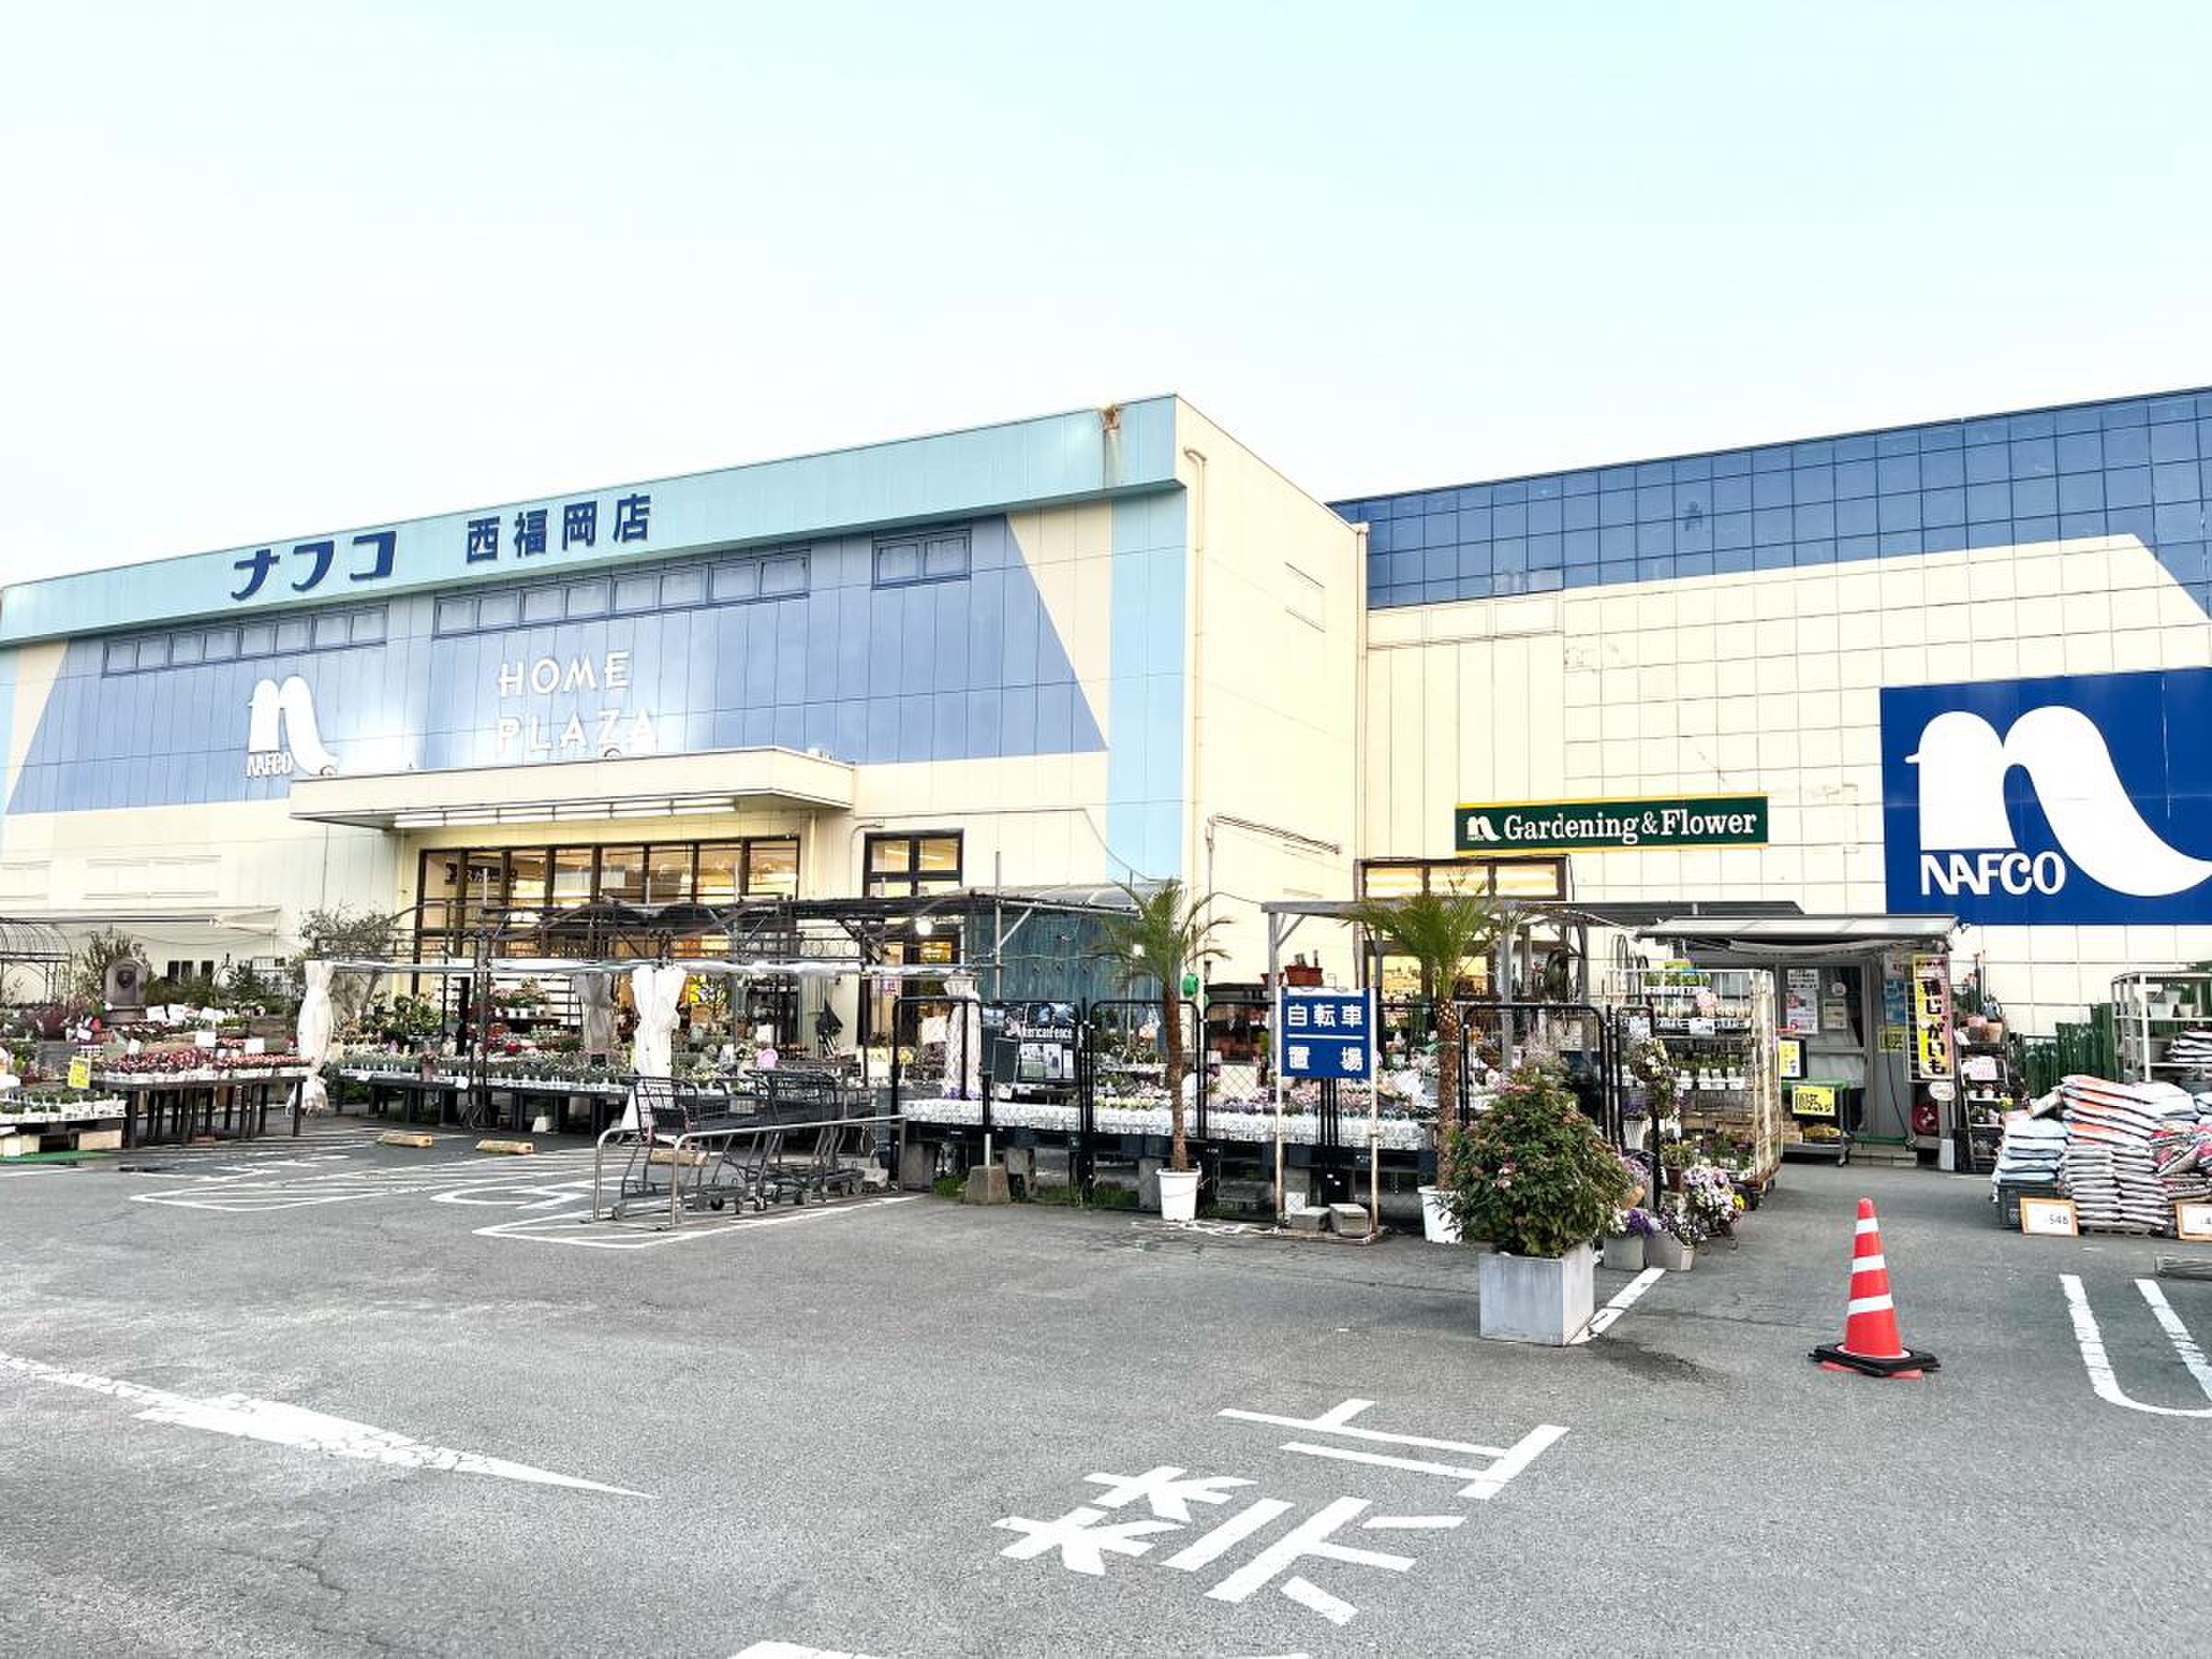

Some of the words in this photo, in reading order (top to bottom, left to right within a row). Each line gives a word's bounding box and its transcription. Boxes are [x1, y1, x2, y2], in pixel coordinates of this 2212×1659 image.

[230, 530, 397, 601] ナフコ
[466, 493, 651, 564] 西福岡店
[499, 650, 630, 699] HOME
[499, 707, 659, 754] PLAZA
[246, 752, 293, 777] NAFCO
[1920, 851, 2066, 896] NAFCO
[1288, 1004, 1363, 1028] 自転車
[1288, 1046, 1363, 1072] 置場
